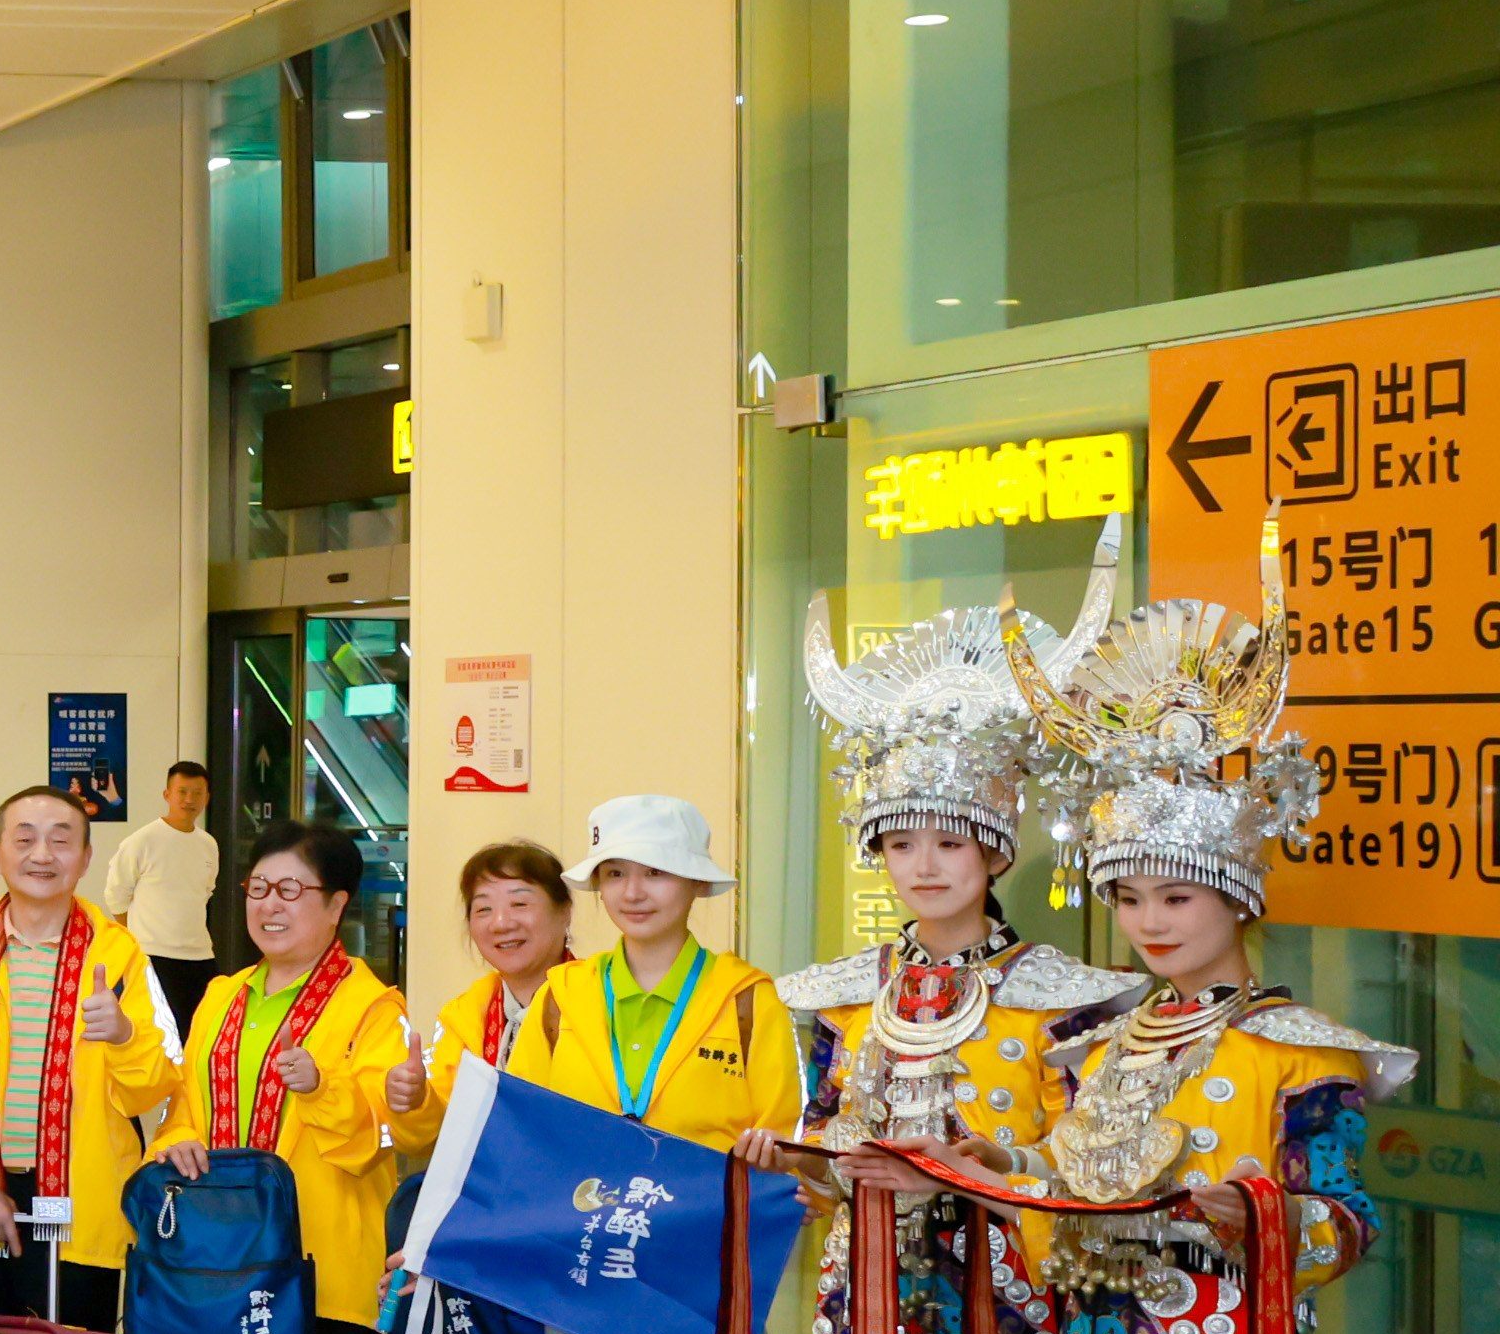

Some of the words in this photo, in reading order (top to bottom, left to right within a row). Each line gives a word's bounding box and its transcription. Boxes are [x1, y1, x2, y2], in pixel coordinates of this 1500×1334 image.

[1373, 358, 1466, 424] 出口
[1374, 436, 1460, 489] Exit
[1282, 526, 1433, 591] 15号门
[1285, 604, 1434, 656] Gate15
